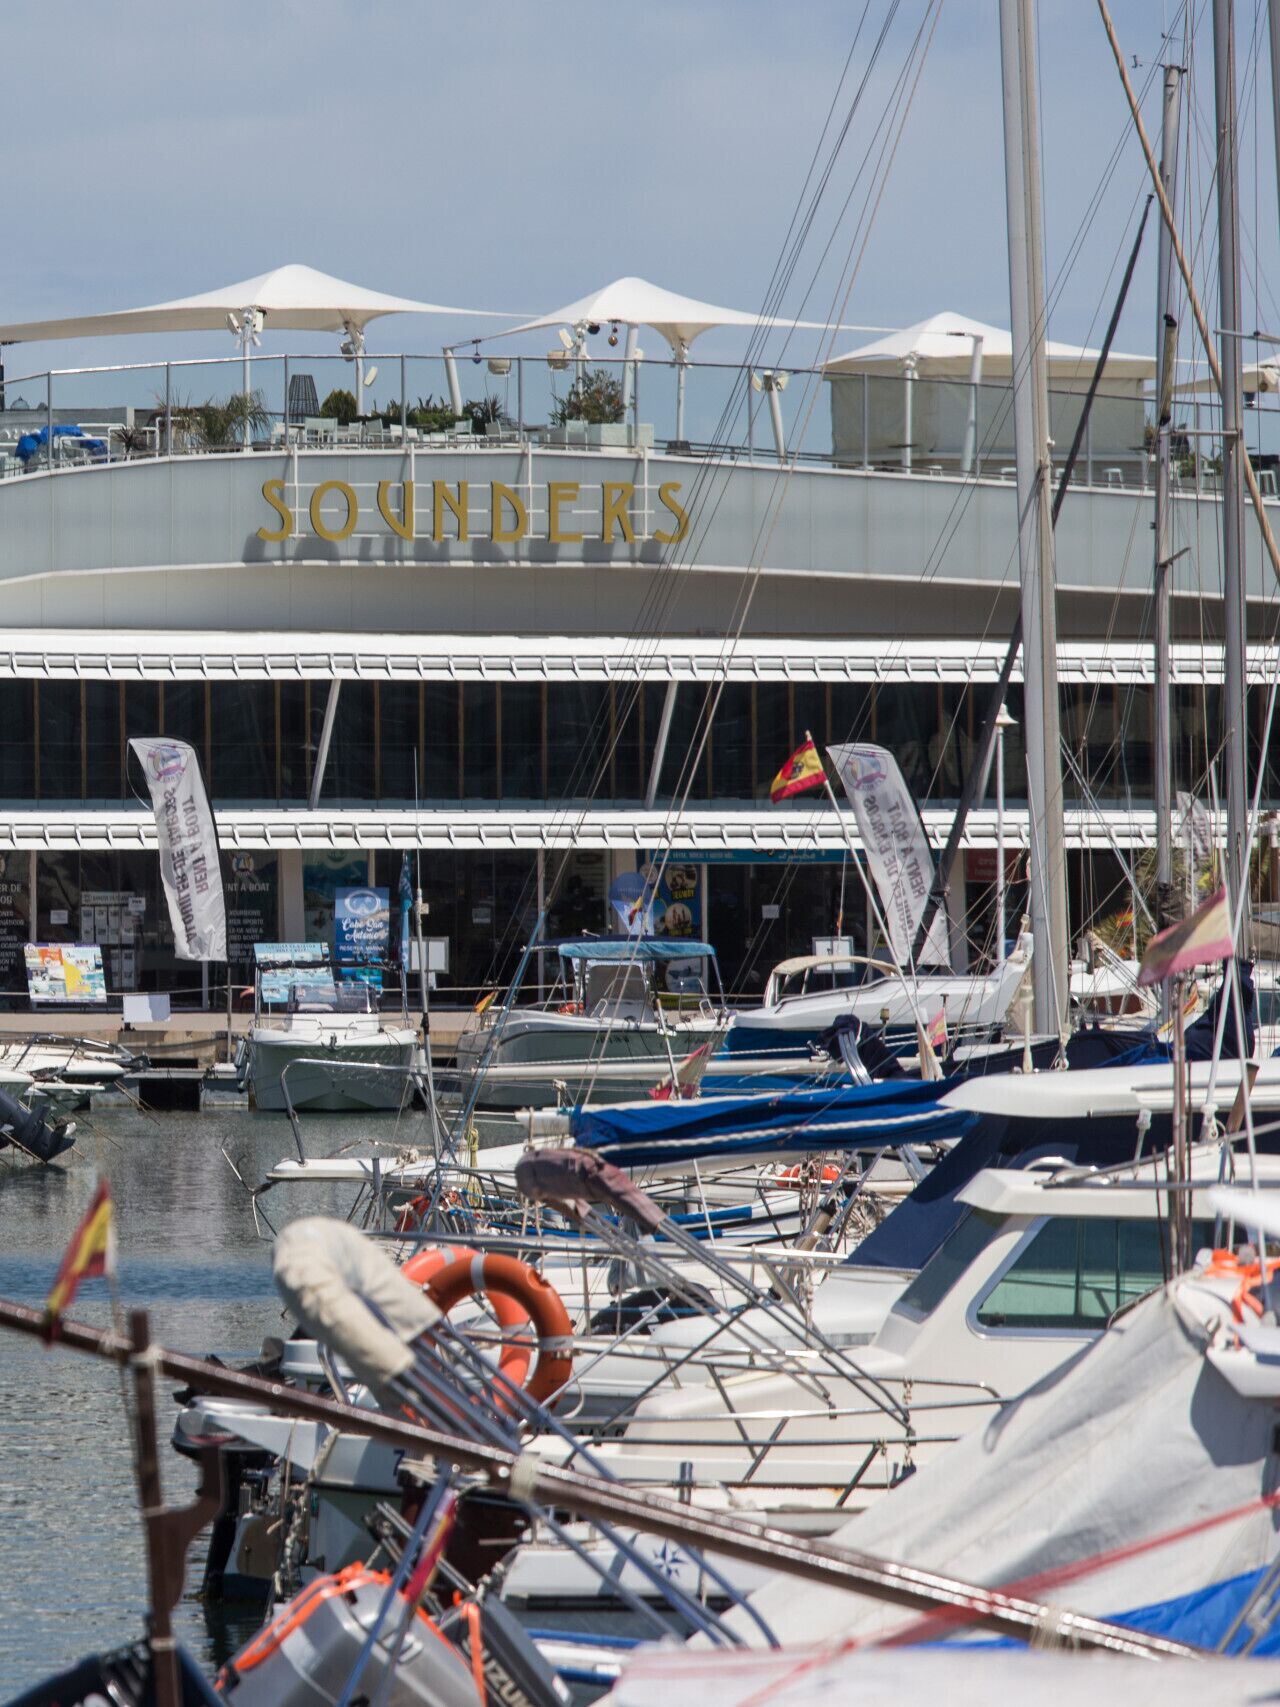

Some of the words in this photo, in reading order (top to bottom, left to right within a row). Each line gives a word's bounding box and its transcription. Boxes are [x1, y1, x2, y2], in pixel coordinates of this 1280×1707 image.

[256, 479, 689, 544] SOUNDERS
[10, 883, 22, 893] DE
[249, 883, 270, 892] BOAT
